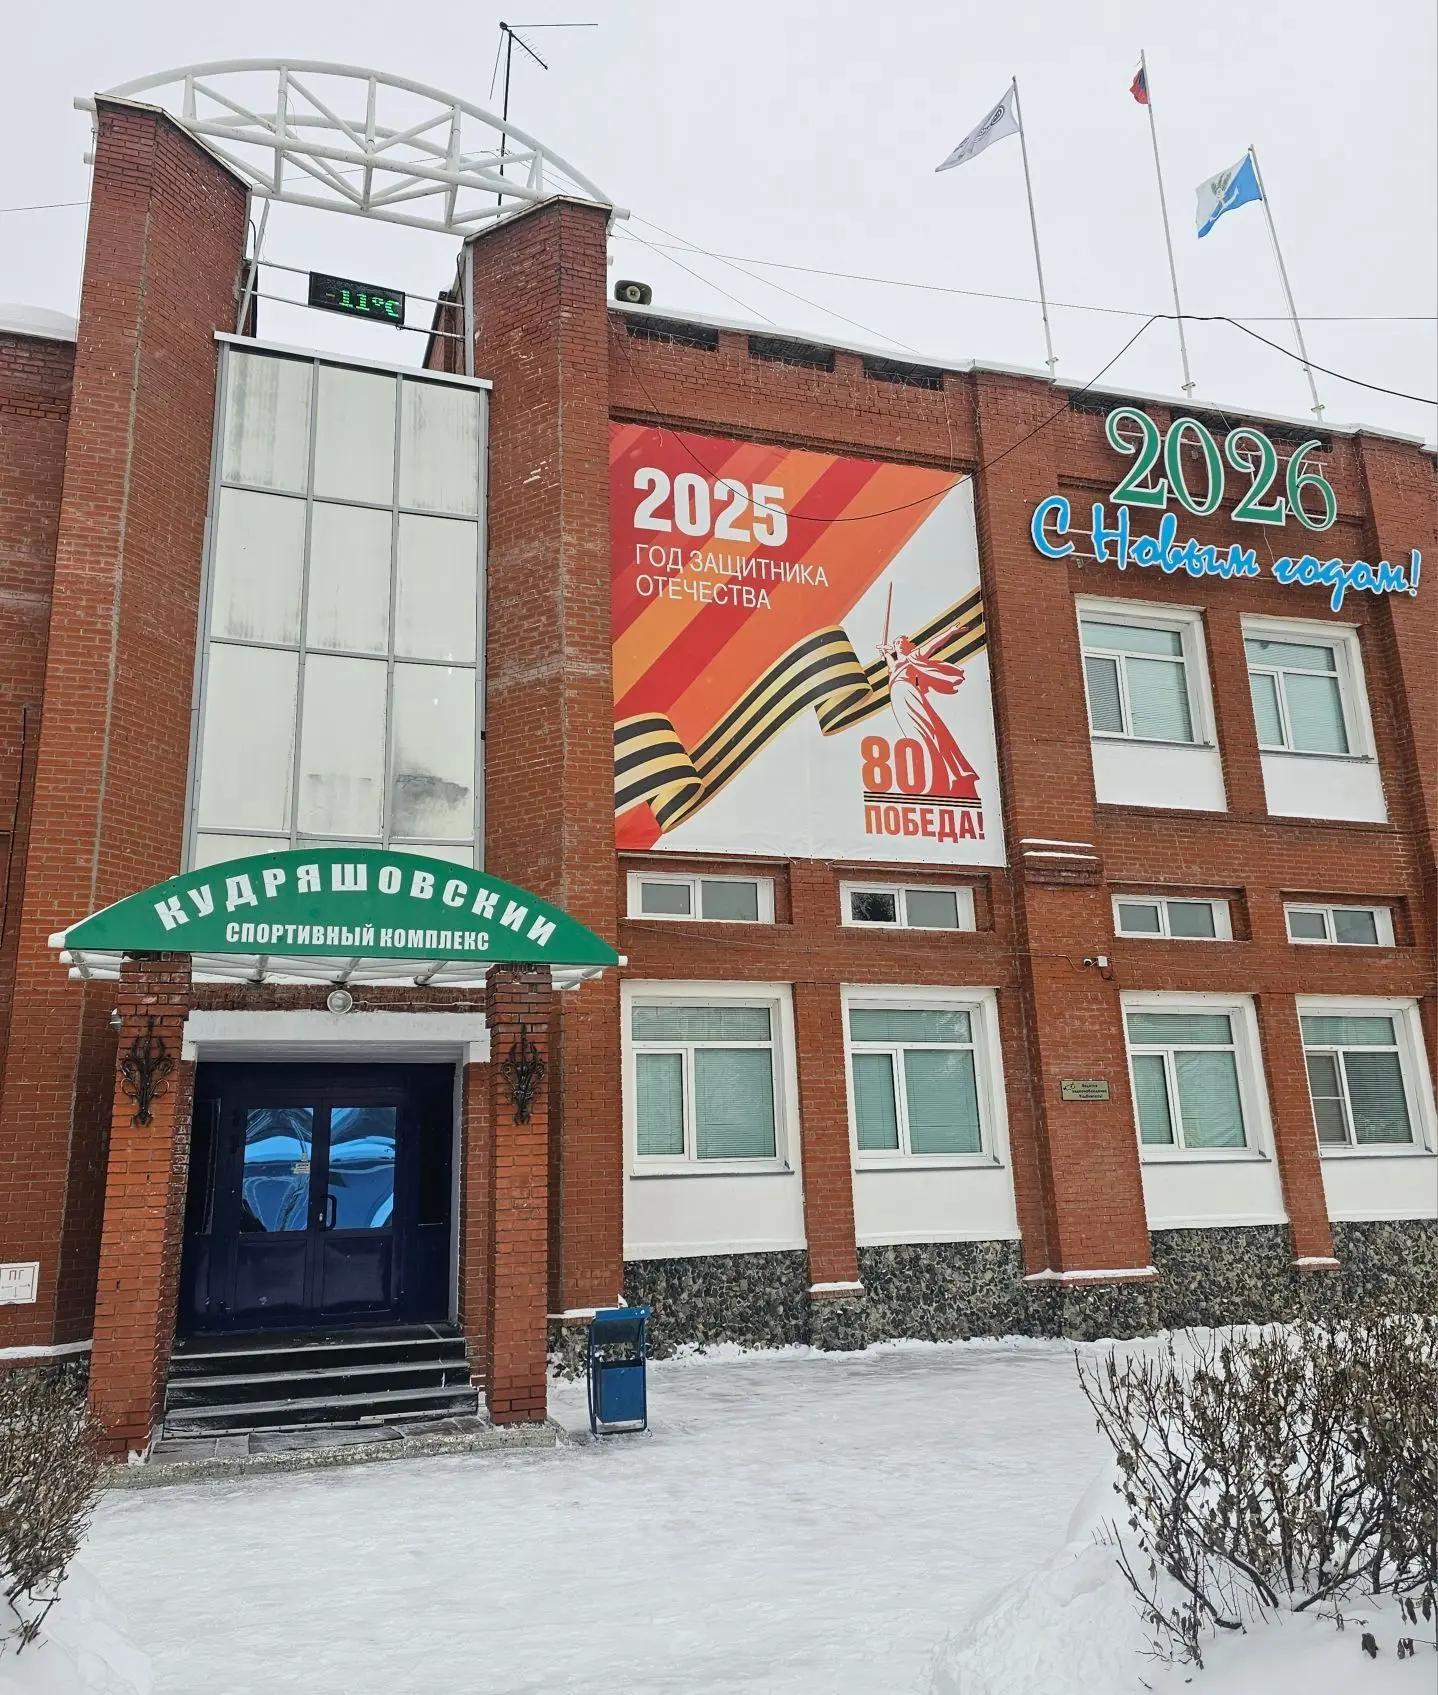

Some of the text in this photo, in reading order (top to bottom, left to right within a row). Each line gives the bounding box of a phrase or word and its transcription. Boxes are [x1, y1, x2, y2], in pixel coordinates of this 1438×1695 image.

[1105, 406, 1338, 532] 2026
[633, 466, 788, 547] 2025
[636, 543, 829, 587] ГОД ЗАЩИТНИКА
[1031, 495, 1422, 612] С Новым годом!
[635, 574, 772, 609] ОТЕЧЕСТВА
[860, 735, 927, 794] 80
[864, 804, 986, 844] ПОБЕДА!
[225, 923, 490, 951] СПОРТИВНЫЙ КОМПЛЕКС
[9, 1269, 25, 1281] ПГ
